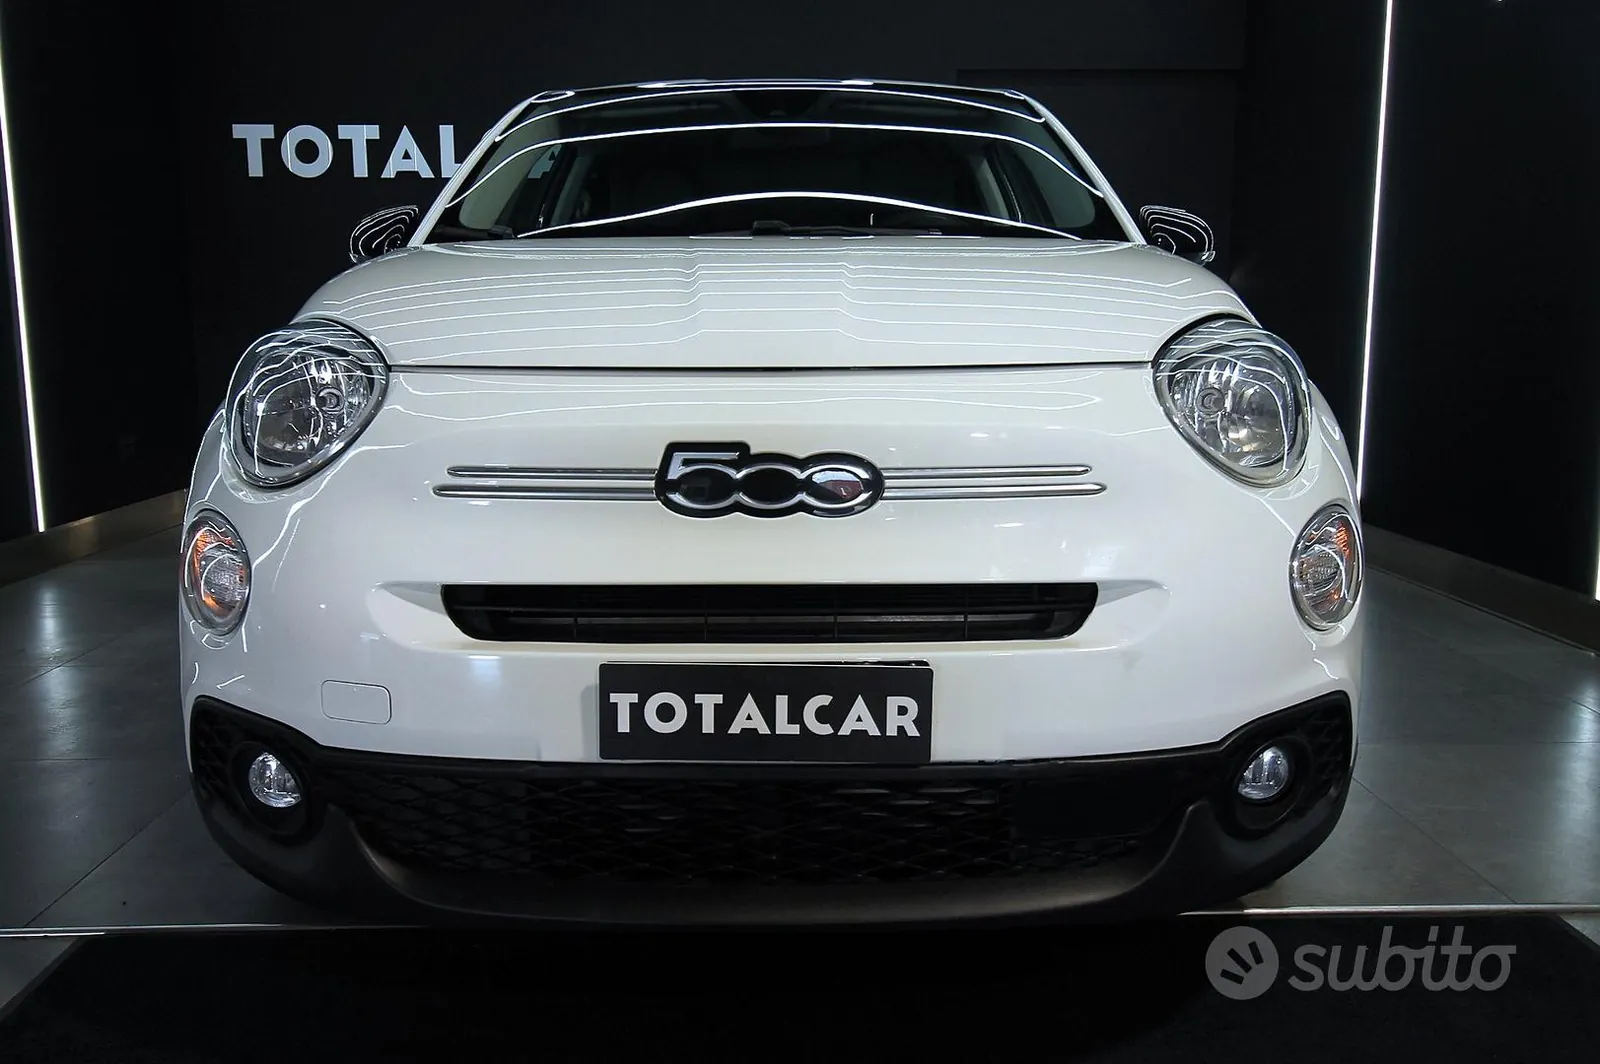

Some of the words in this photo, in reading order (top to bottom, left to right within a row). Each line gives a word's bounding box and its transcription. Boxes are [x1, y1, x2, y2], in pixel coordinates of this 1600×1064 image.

[232, 124, 562, 178] TOTAL
[665, 451, 873, 509] 500
[609, 691, 921, 737] TOTALCAR
